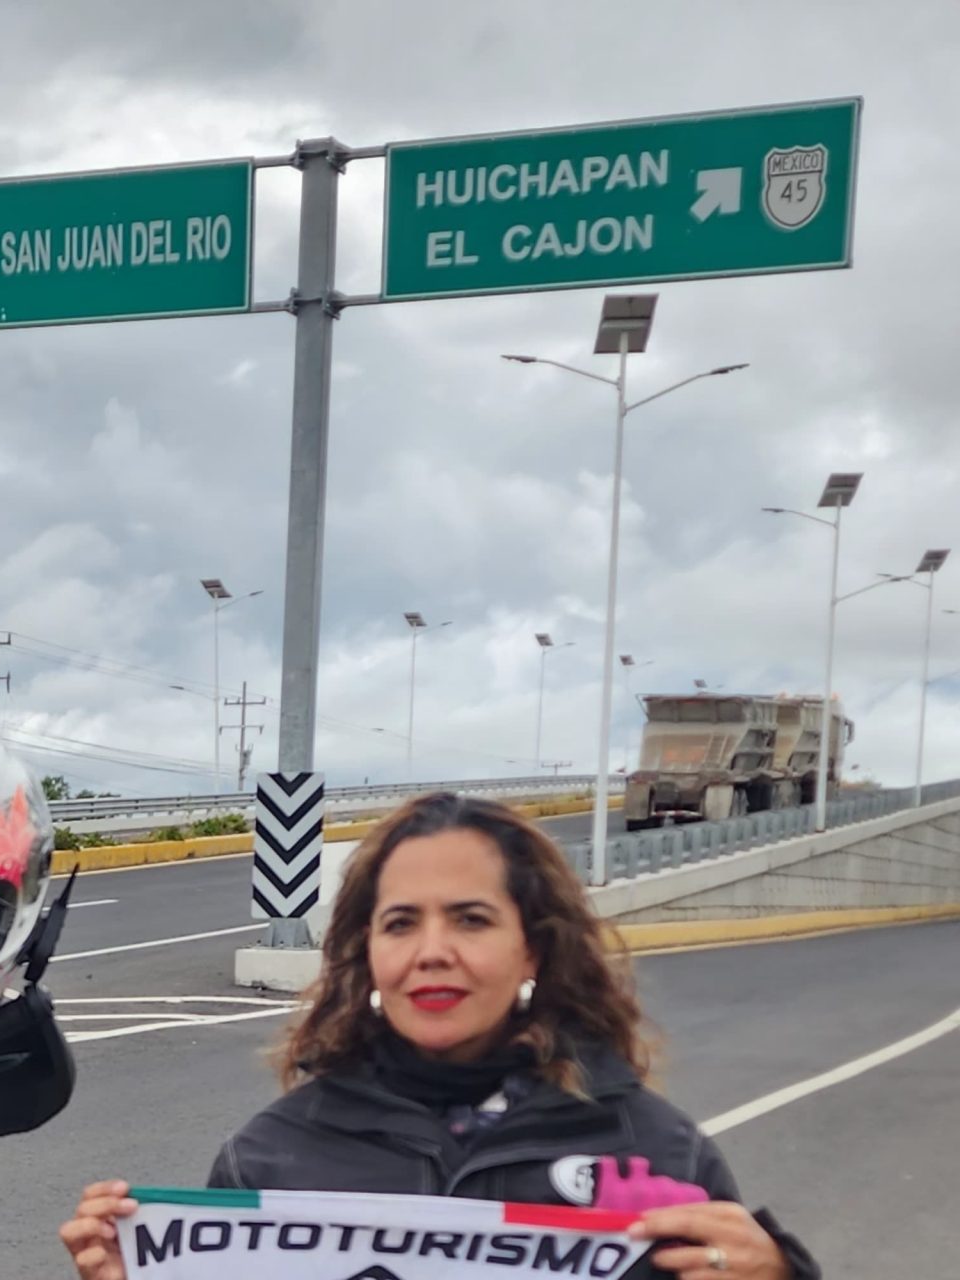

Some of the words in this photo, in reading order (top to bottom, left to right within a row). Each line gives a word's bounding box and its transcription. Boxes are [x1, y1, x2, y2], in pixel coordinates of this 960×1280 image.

[416, 149, 670, 208] HUICHAPAN
[772, 153, 820, 173] MEXICO
[780, 178, 808, 203] 45
[0, 230, 51, 275] SAN
[56, 222, 124, 271] JUAN
[129, 219, 180, 266] DEL
[186, 214, 233, 260] RIO
[426, 230, 479, 268] EL
[501, 214, 654, 261] CAJON
[135, 1219, 629, 1279] MOTOTURISMO
